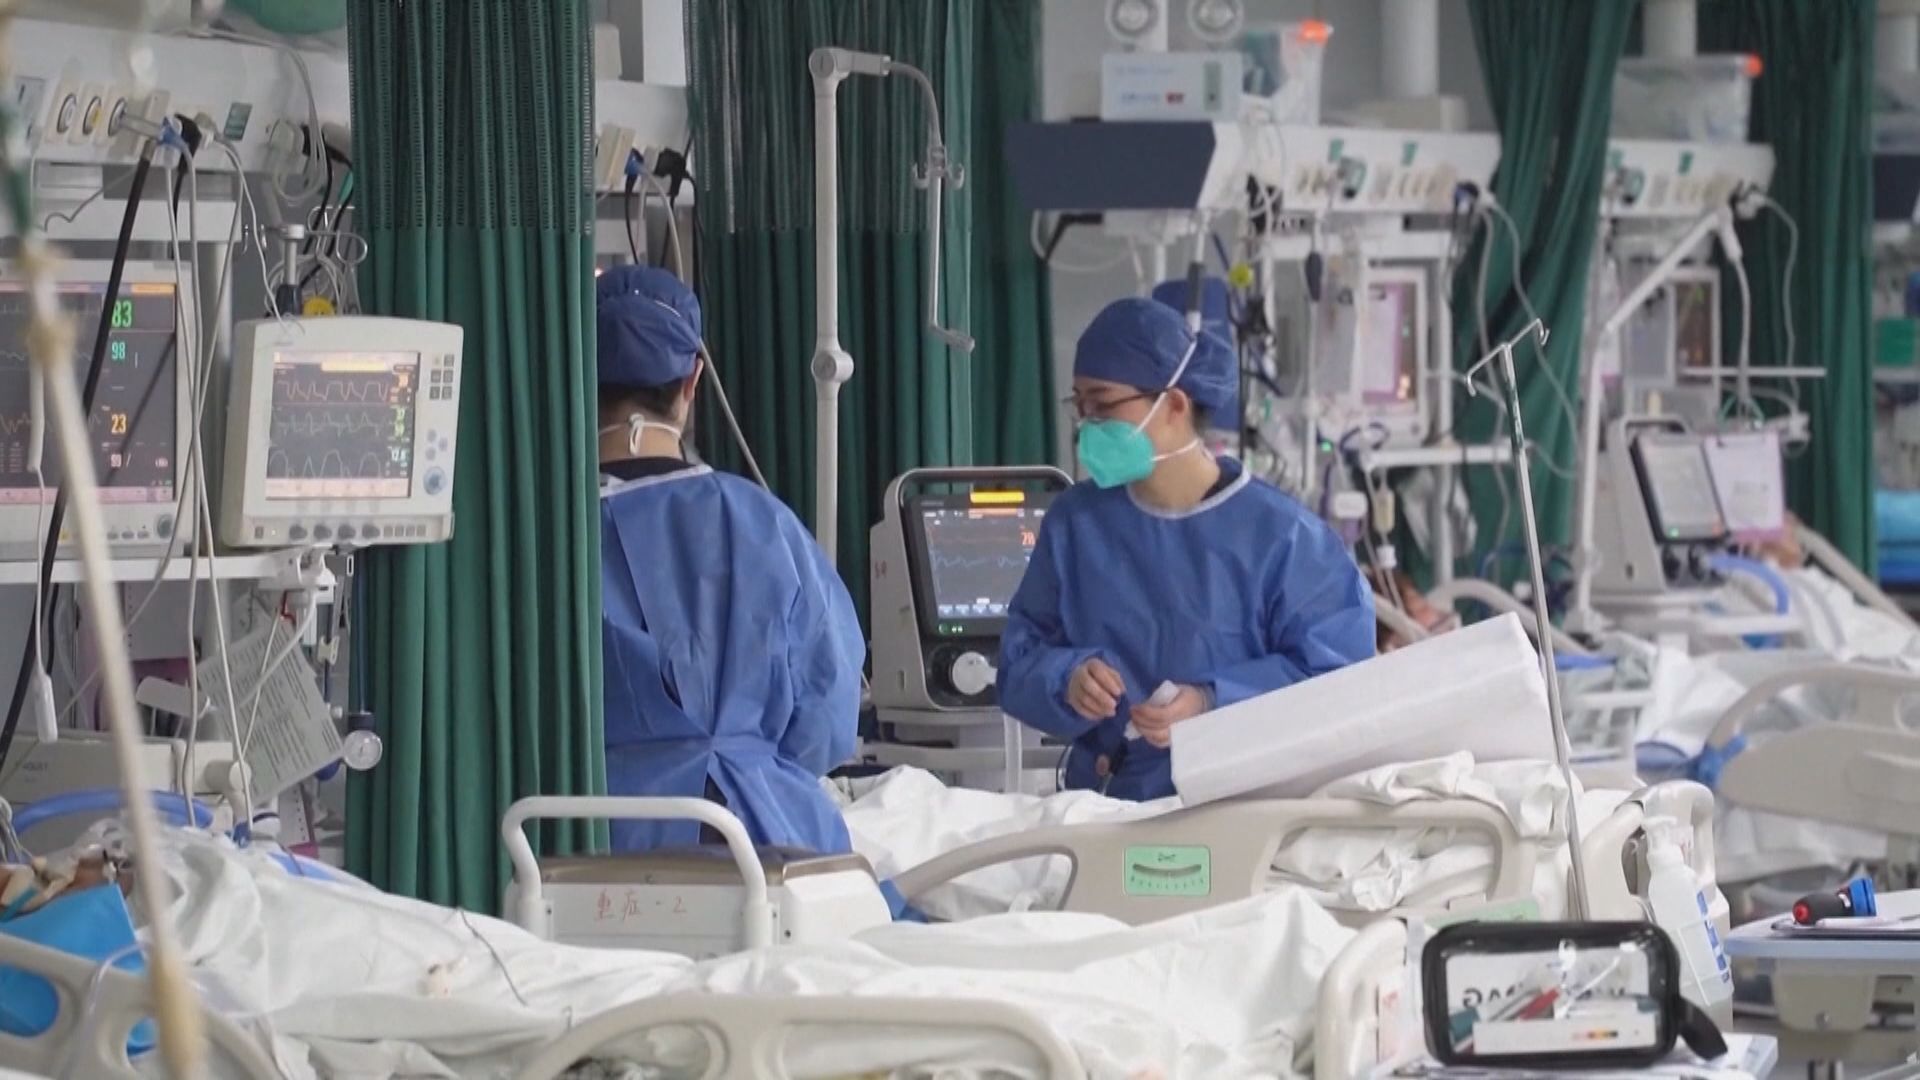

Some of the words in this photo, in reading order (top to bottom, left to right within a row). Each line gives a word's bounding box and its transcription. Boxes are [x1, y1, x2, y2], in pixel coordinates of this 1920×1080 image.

[112, 300, 132, 328] 83
[111, 341, 126, 360] 98
[111, 413, 127, 434] 23
